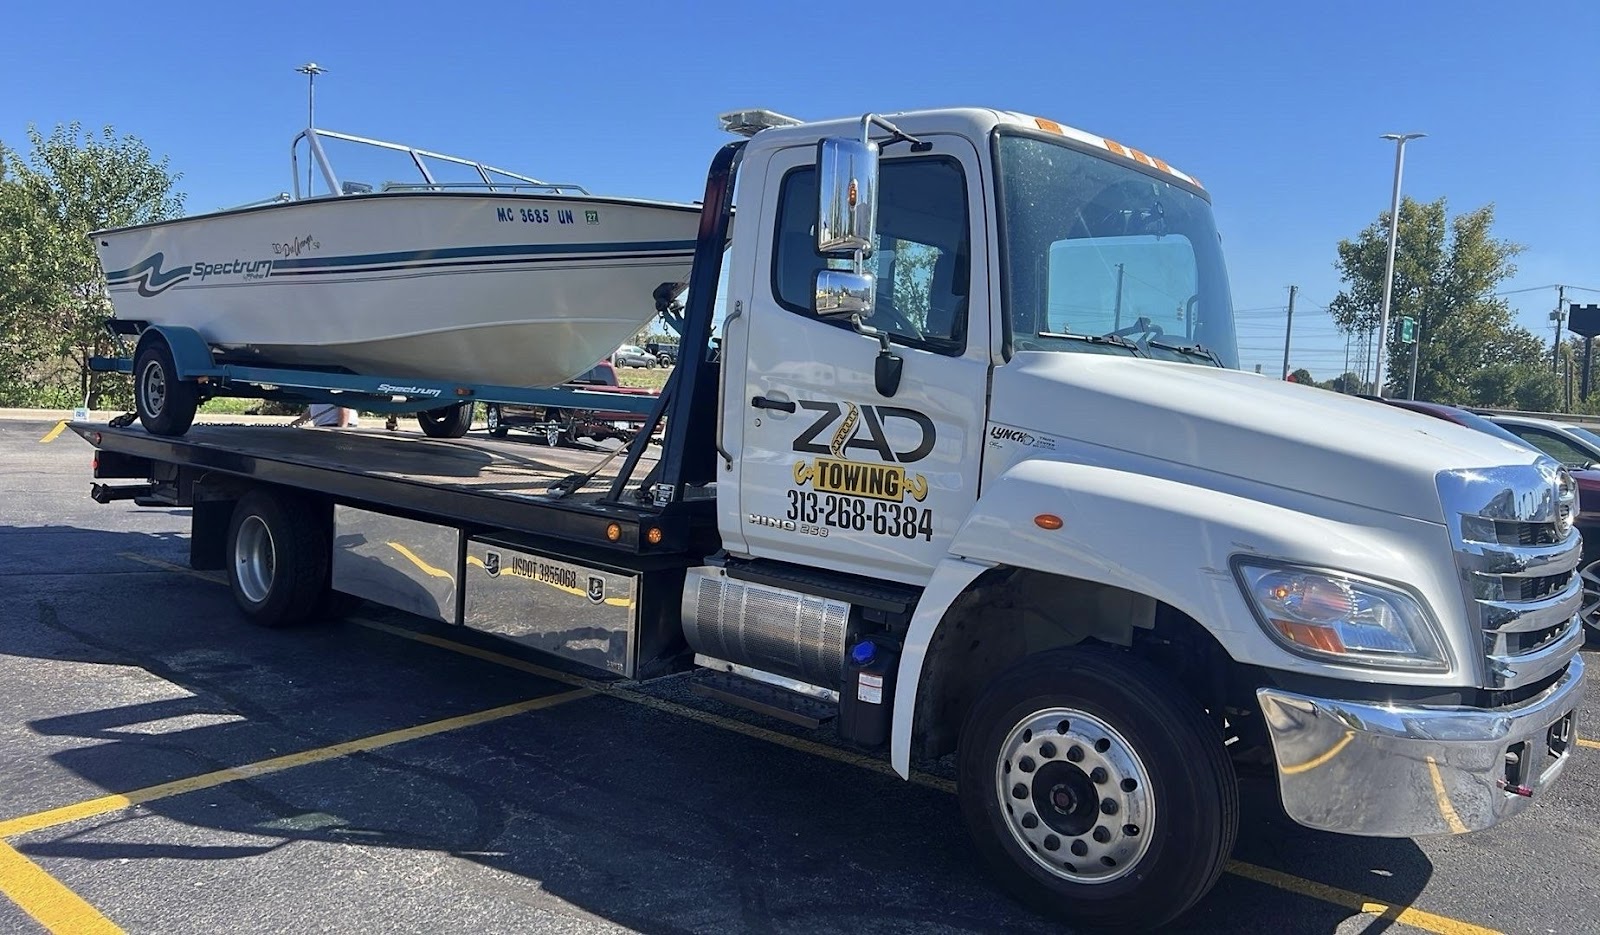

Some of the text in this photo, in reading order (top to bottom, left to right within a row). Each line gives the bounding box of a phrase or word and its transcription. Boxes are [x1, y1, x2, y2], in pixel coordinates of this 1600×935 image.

[496, 207, 574, 224] MC 3685 UN
[192, 258, 272, 281] Spectrum
[377, 383, 442, 398] Spectrum
[792, 399, 936, 463] ZAD
[990, 427, 1026, 443] LYNCH
[817, 461, 900, 497] TOWING
[749, 514, 829, 538] HINO 258
[786, 489, 934, 542] 313-268-6384
[512, 556, 576, 589] USDOT 3855068
